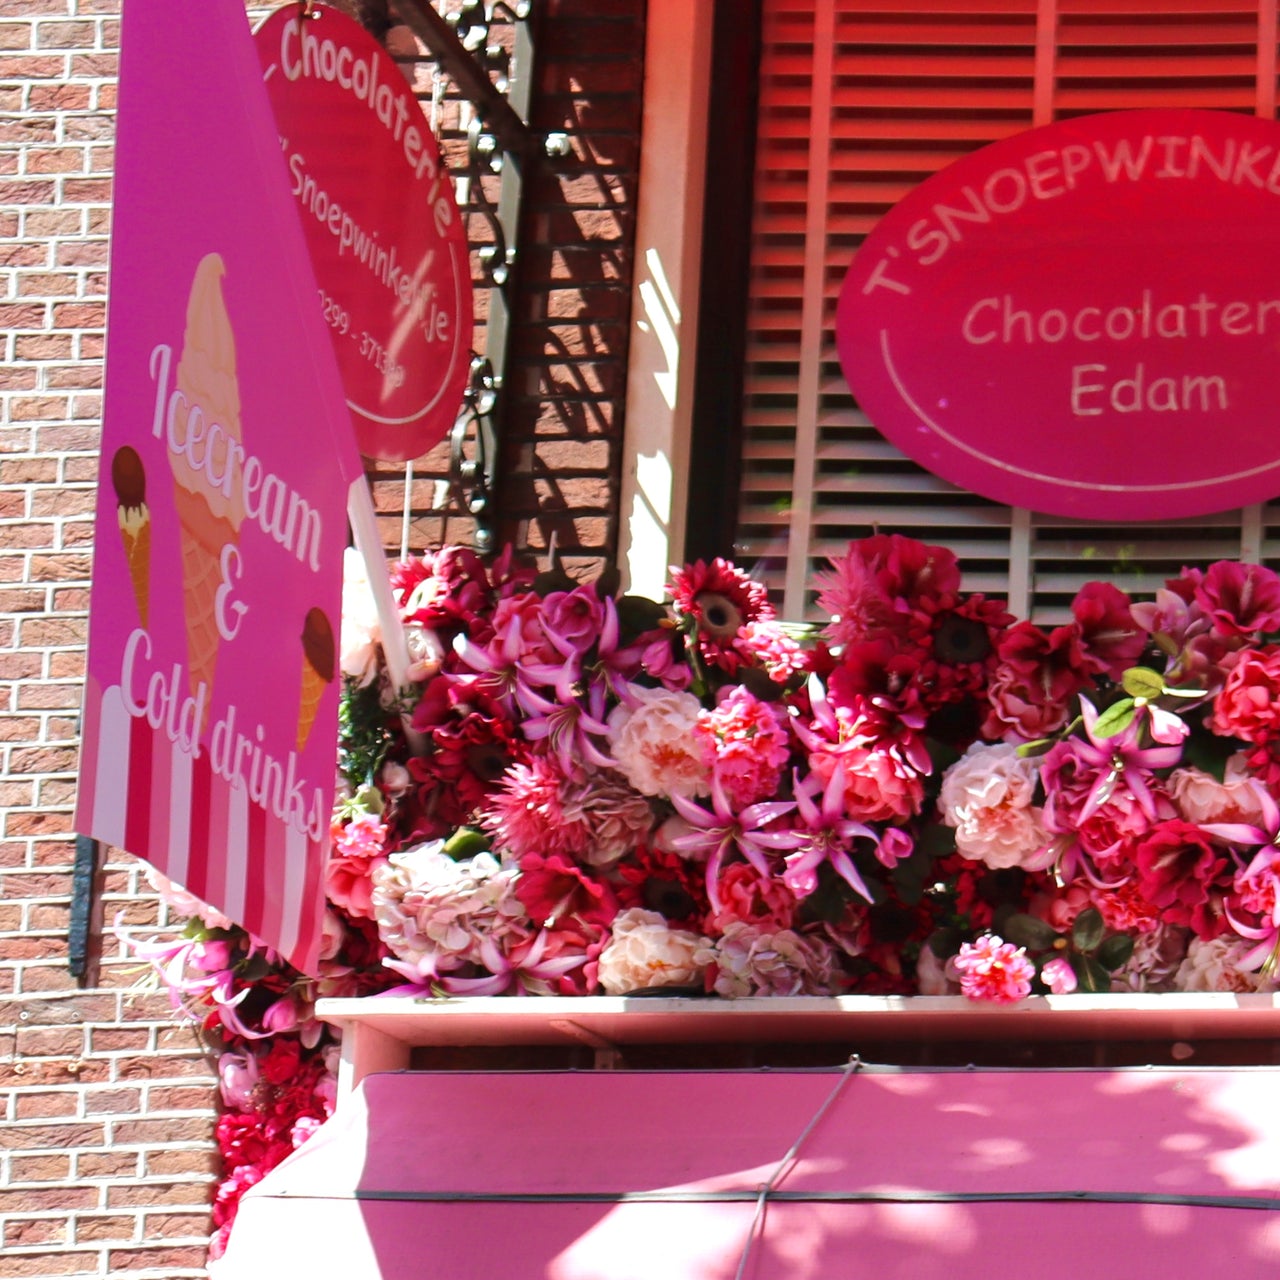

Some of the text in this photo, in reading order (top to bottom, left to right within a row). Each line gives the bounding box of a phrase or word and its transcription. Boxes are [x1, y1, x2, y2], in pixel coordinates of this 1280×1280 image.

[281, 20, 452, 238] Chocolaterie
[149, 344, 323, 573] Icecream
[1071, 363, 1228, 416] Edam
[214, 543, 250, 641] &
[120, 629, 324, 842] Cold drinks
